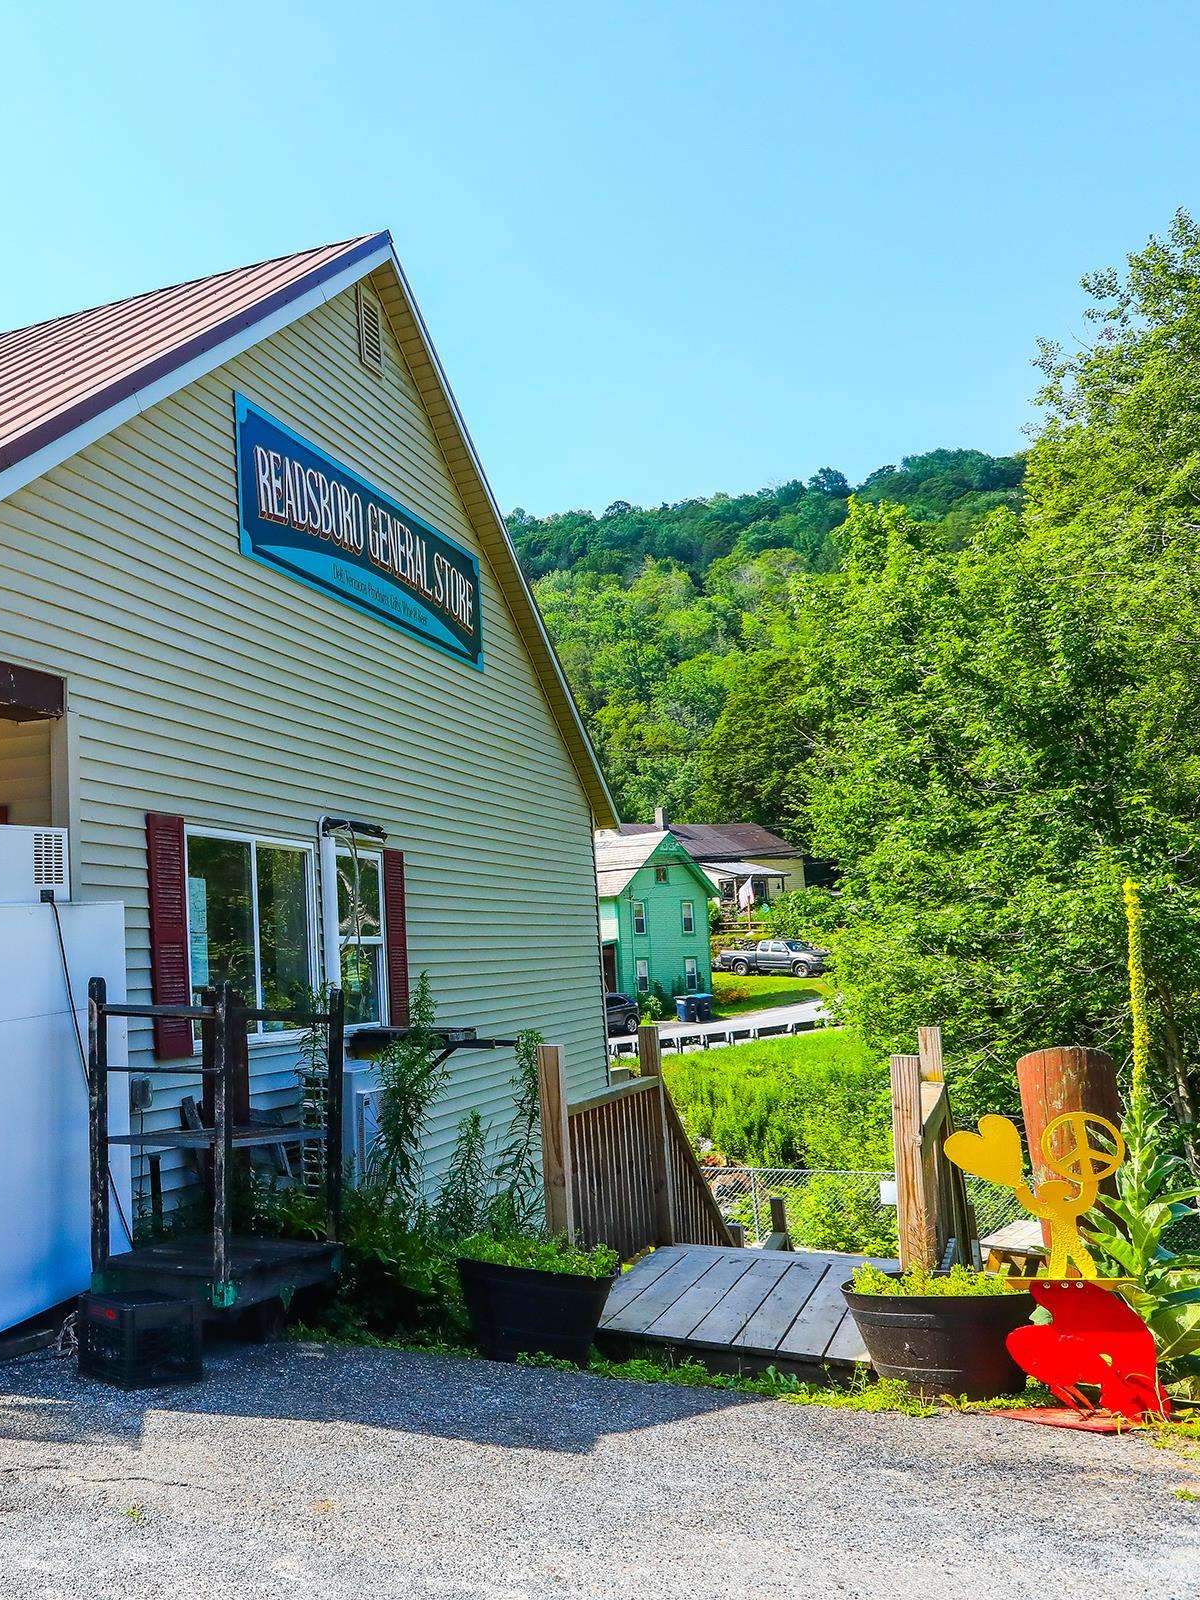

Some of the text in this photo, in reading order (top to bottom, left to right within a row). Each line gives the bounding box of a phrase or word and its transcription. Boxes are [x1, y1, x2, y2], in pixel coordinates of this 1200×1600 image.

[253, 445, 475, 636] READSBORO GENERAL STORE
